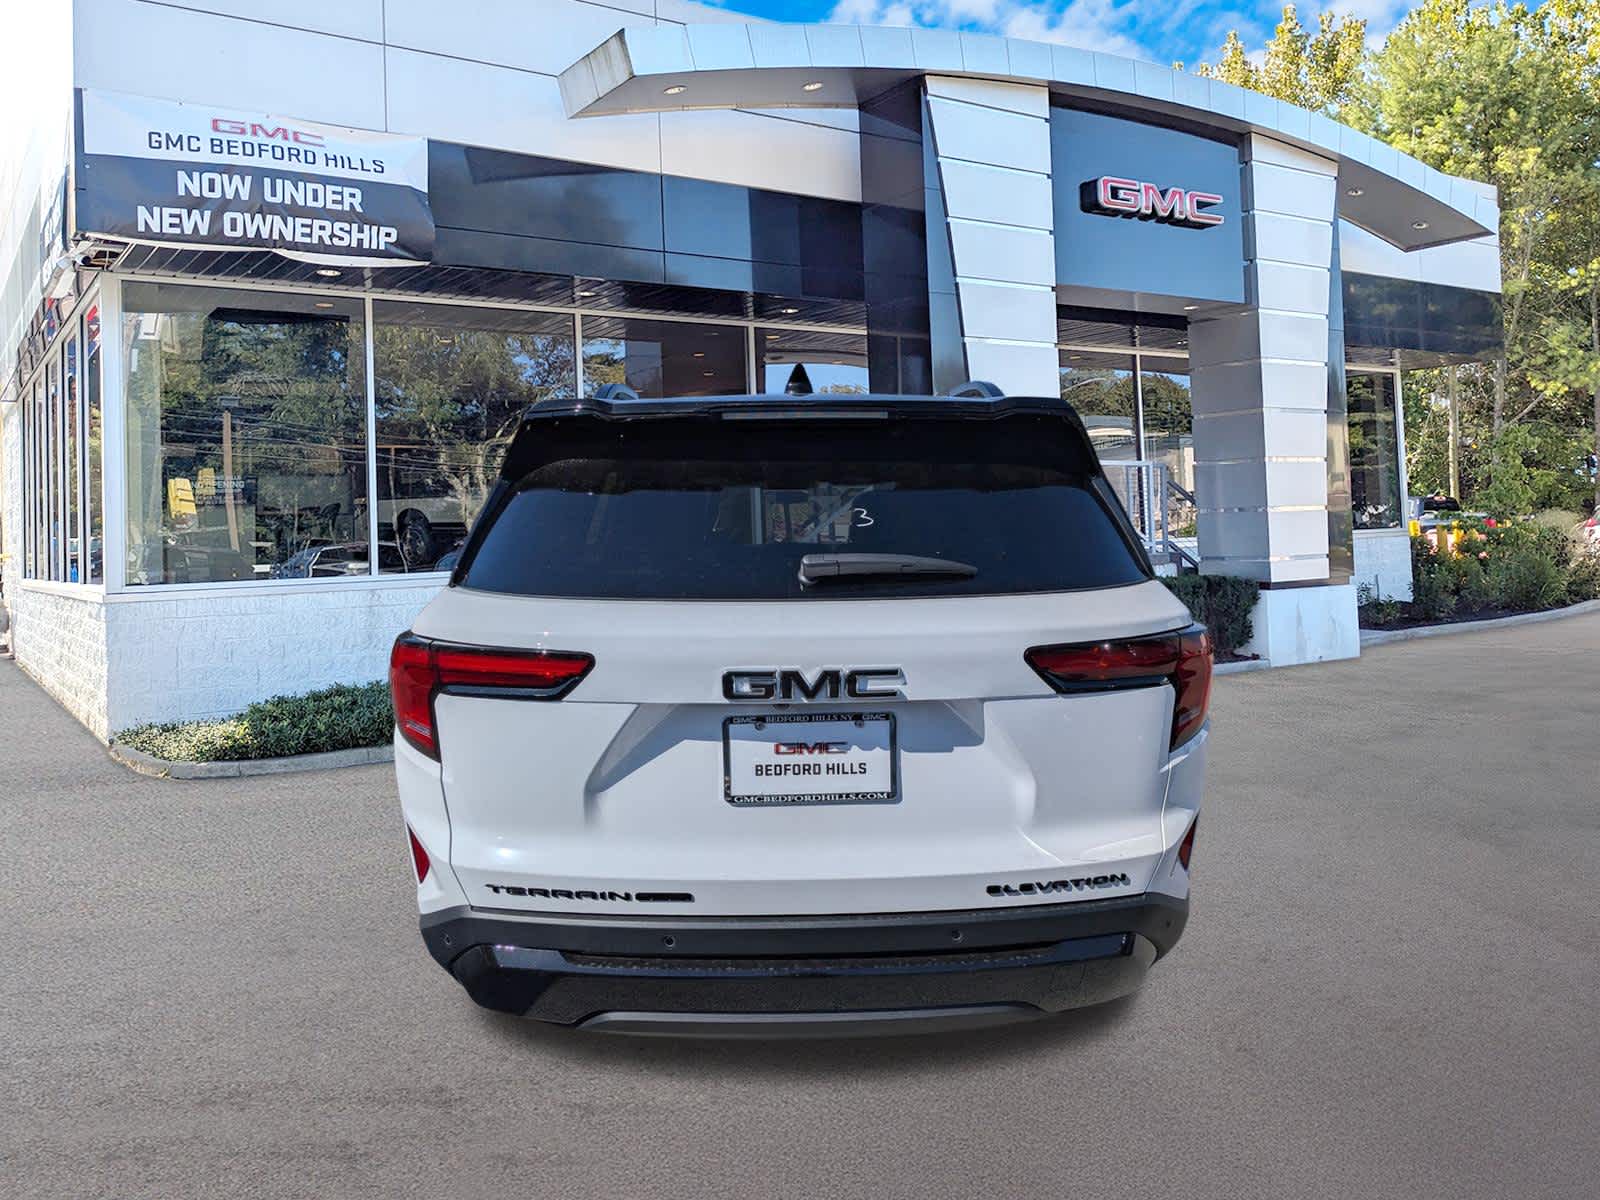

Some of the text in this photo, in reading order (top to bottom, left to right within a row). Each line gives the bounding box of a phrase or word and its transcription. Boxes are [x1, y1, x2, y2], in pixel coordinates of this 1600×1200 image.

[211, 117, 326, 148] GMC
[148, 131, 385, 174] GMC BEDFORD HILLS
[177, 170, 364, 213] NOW UNDER
[1096, 175, 1225, 225] GMC
[137, 205, 398, 250] NEW OWNERSHIP
[853, 507, 875, 528] 3
[722, 667, 906, 700] GMC
[732, 716, 757, 724] GMC
[765, 713, 854, 723] BEDFORD HILLS NY
[862, 713, 887, 721] GMC
[774, 741, 849, 756] GMC
[755, 762, 867, 776] BEDFORD HILLS
[733, 791, 889, 804] GMCBEDFORDHILLS.COM
[485, 883, 633, 902] TERRAIN
[986, 872, 1130, 896] ELEVATION
